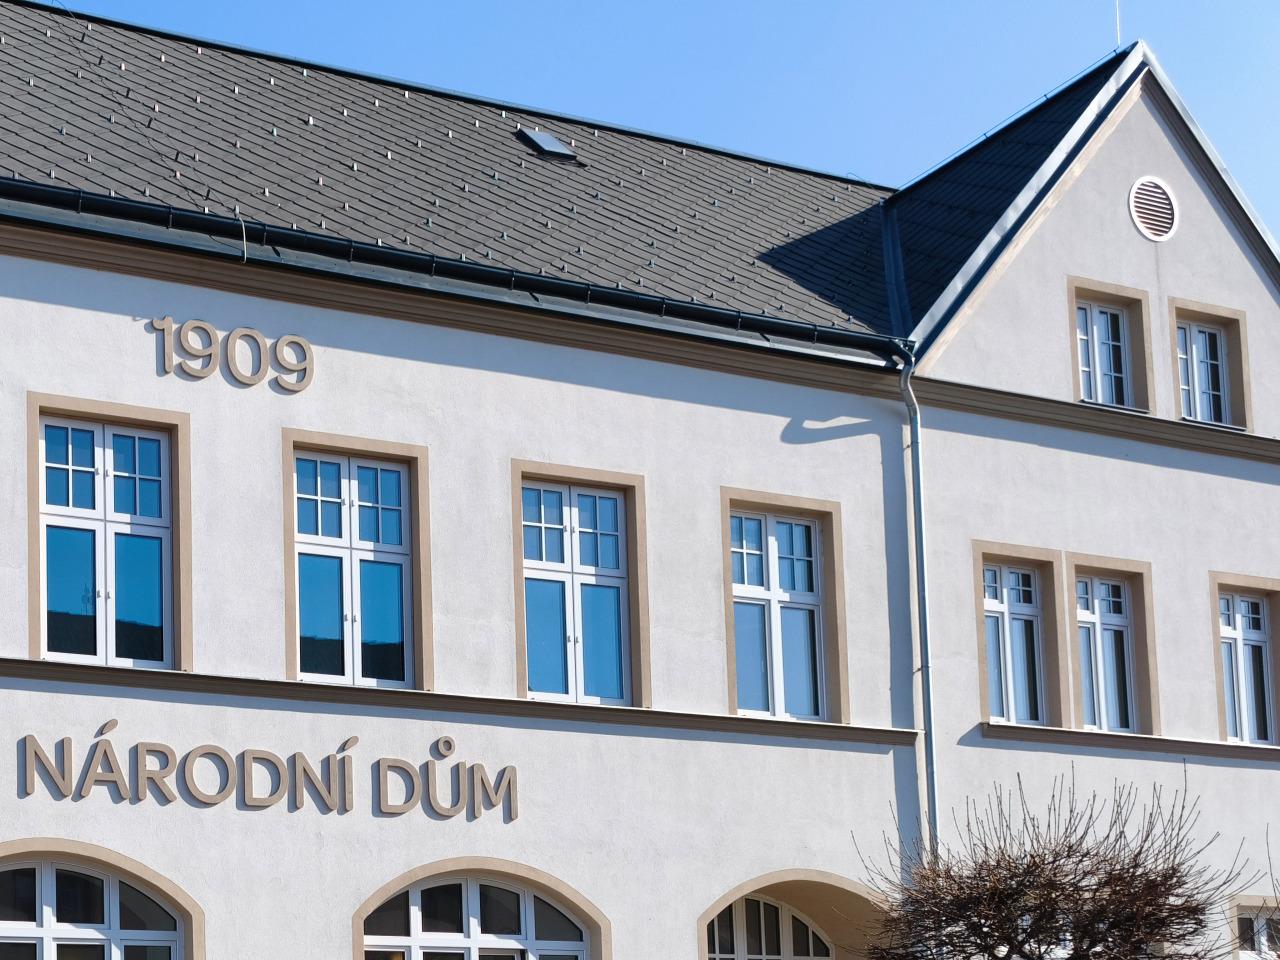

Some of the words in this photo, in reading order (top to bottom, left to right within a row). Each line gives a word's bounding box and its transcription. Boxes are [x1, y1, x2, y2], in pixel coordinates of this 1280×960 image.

[150, 315, 315, 392] 1909
[20, 718, 360, 813] NÁRODNÍ
[375, 735, 519, 823] DŮM
